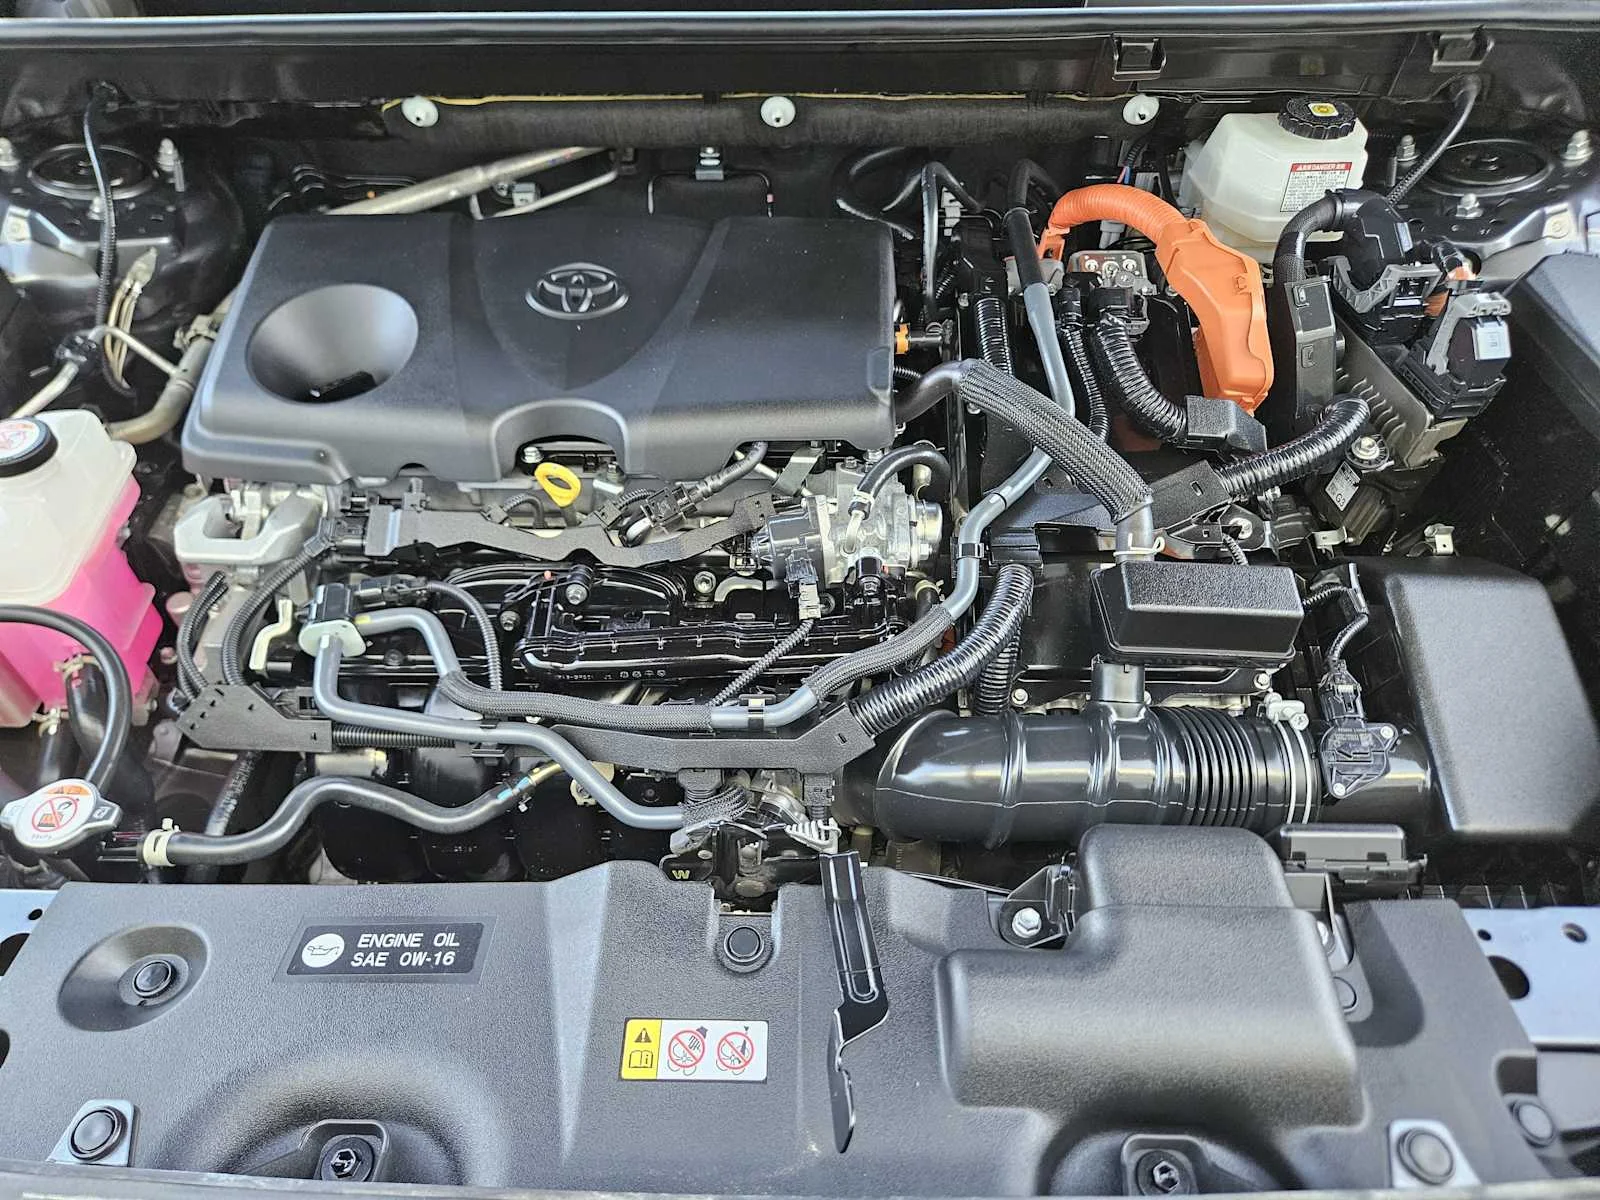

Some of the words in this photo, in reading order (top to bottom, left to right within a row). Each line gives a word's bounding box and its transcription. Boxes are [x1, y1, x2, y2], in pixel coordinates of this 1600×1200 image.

[357, 933, 423, 948] ENGINE
[433, 932, 460, 947] OIL
[350, 952, 389, 967] SAE
[399, 952, 456, 967] 0W-16
